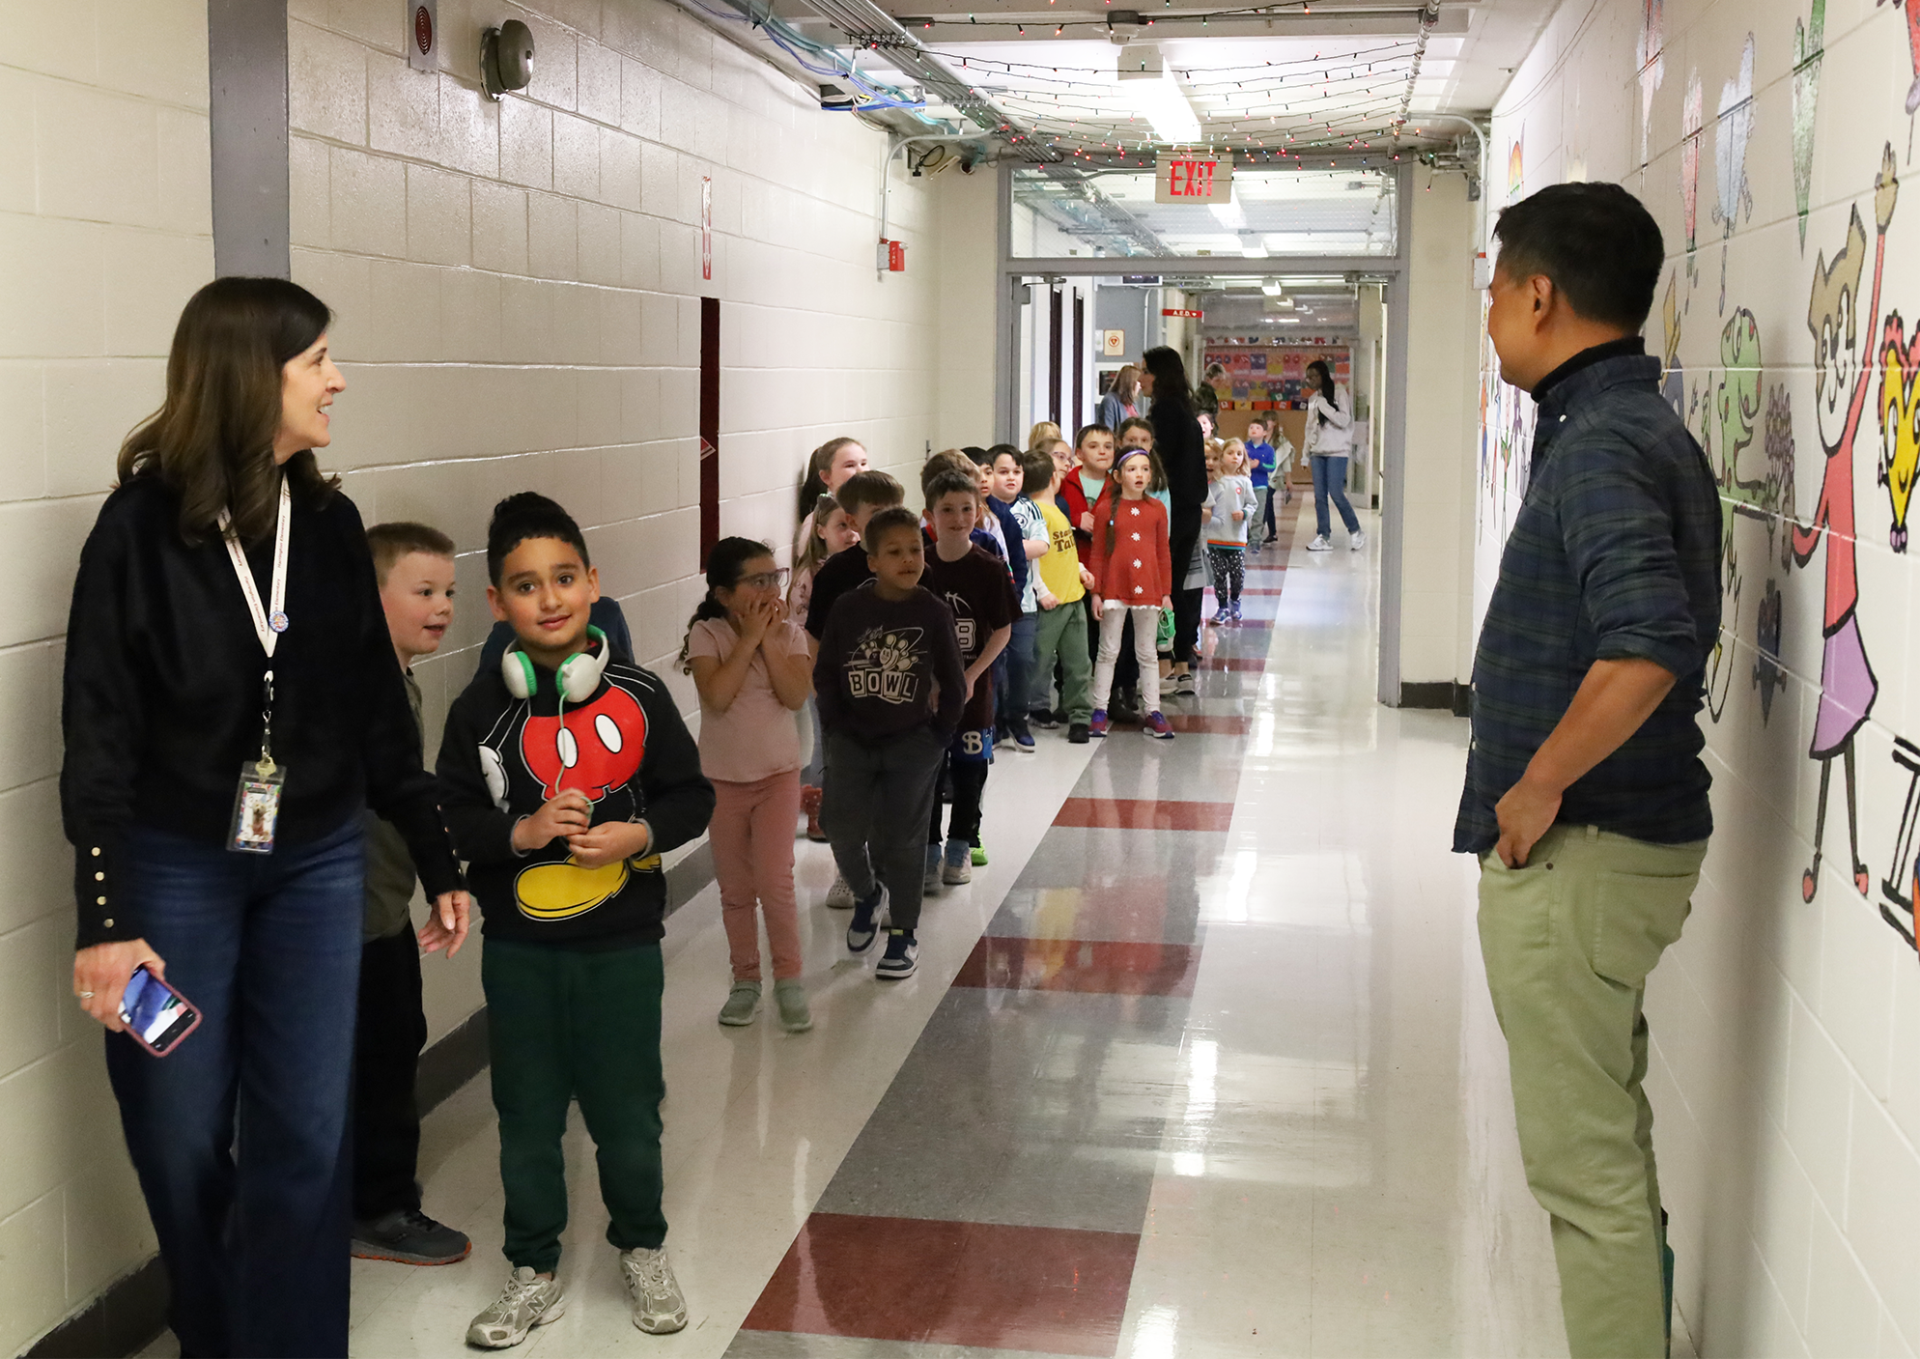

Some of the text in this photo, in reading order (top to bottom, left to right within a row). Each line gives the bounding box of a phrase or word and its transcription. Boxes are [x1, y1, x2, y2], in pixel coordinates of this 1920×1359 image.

[1169, 161, 1217, 196] EXIT
[848, 671, 917, 699] BOWL
[962, 730, 983, 755] B
